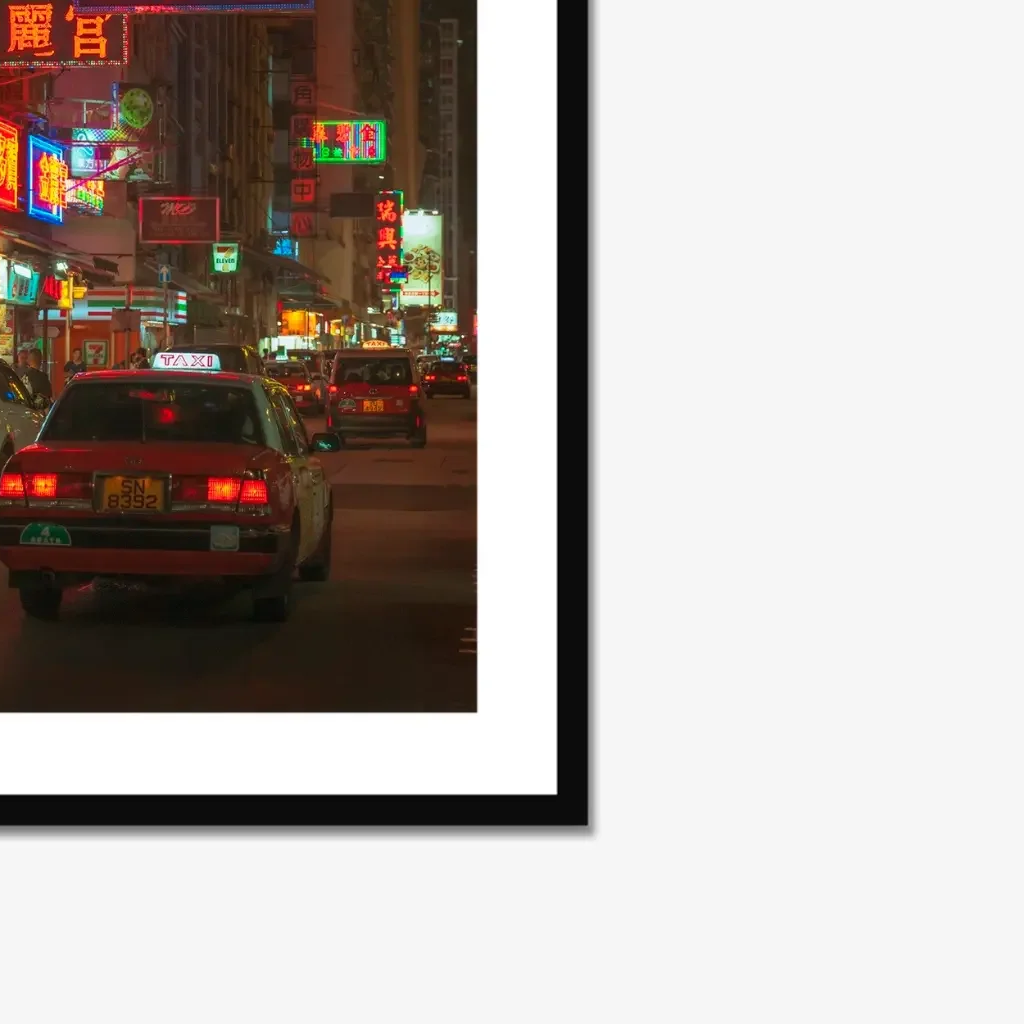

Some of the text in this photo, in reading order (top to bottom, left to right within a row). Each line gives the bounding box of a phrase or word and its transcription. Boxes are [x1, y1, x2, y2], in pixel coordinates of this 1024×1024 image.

[160, 354, 213, 367] TAXI
[121, 479, 145, 495] SN
[107, 494, 158, 509] 8392
[40, 526, 51, 536] 4
